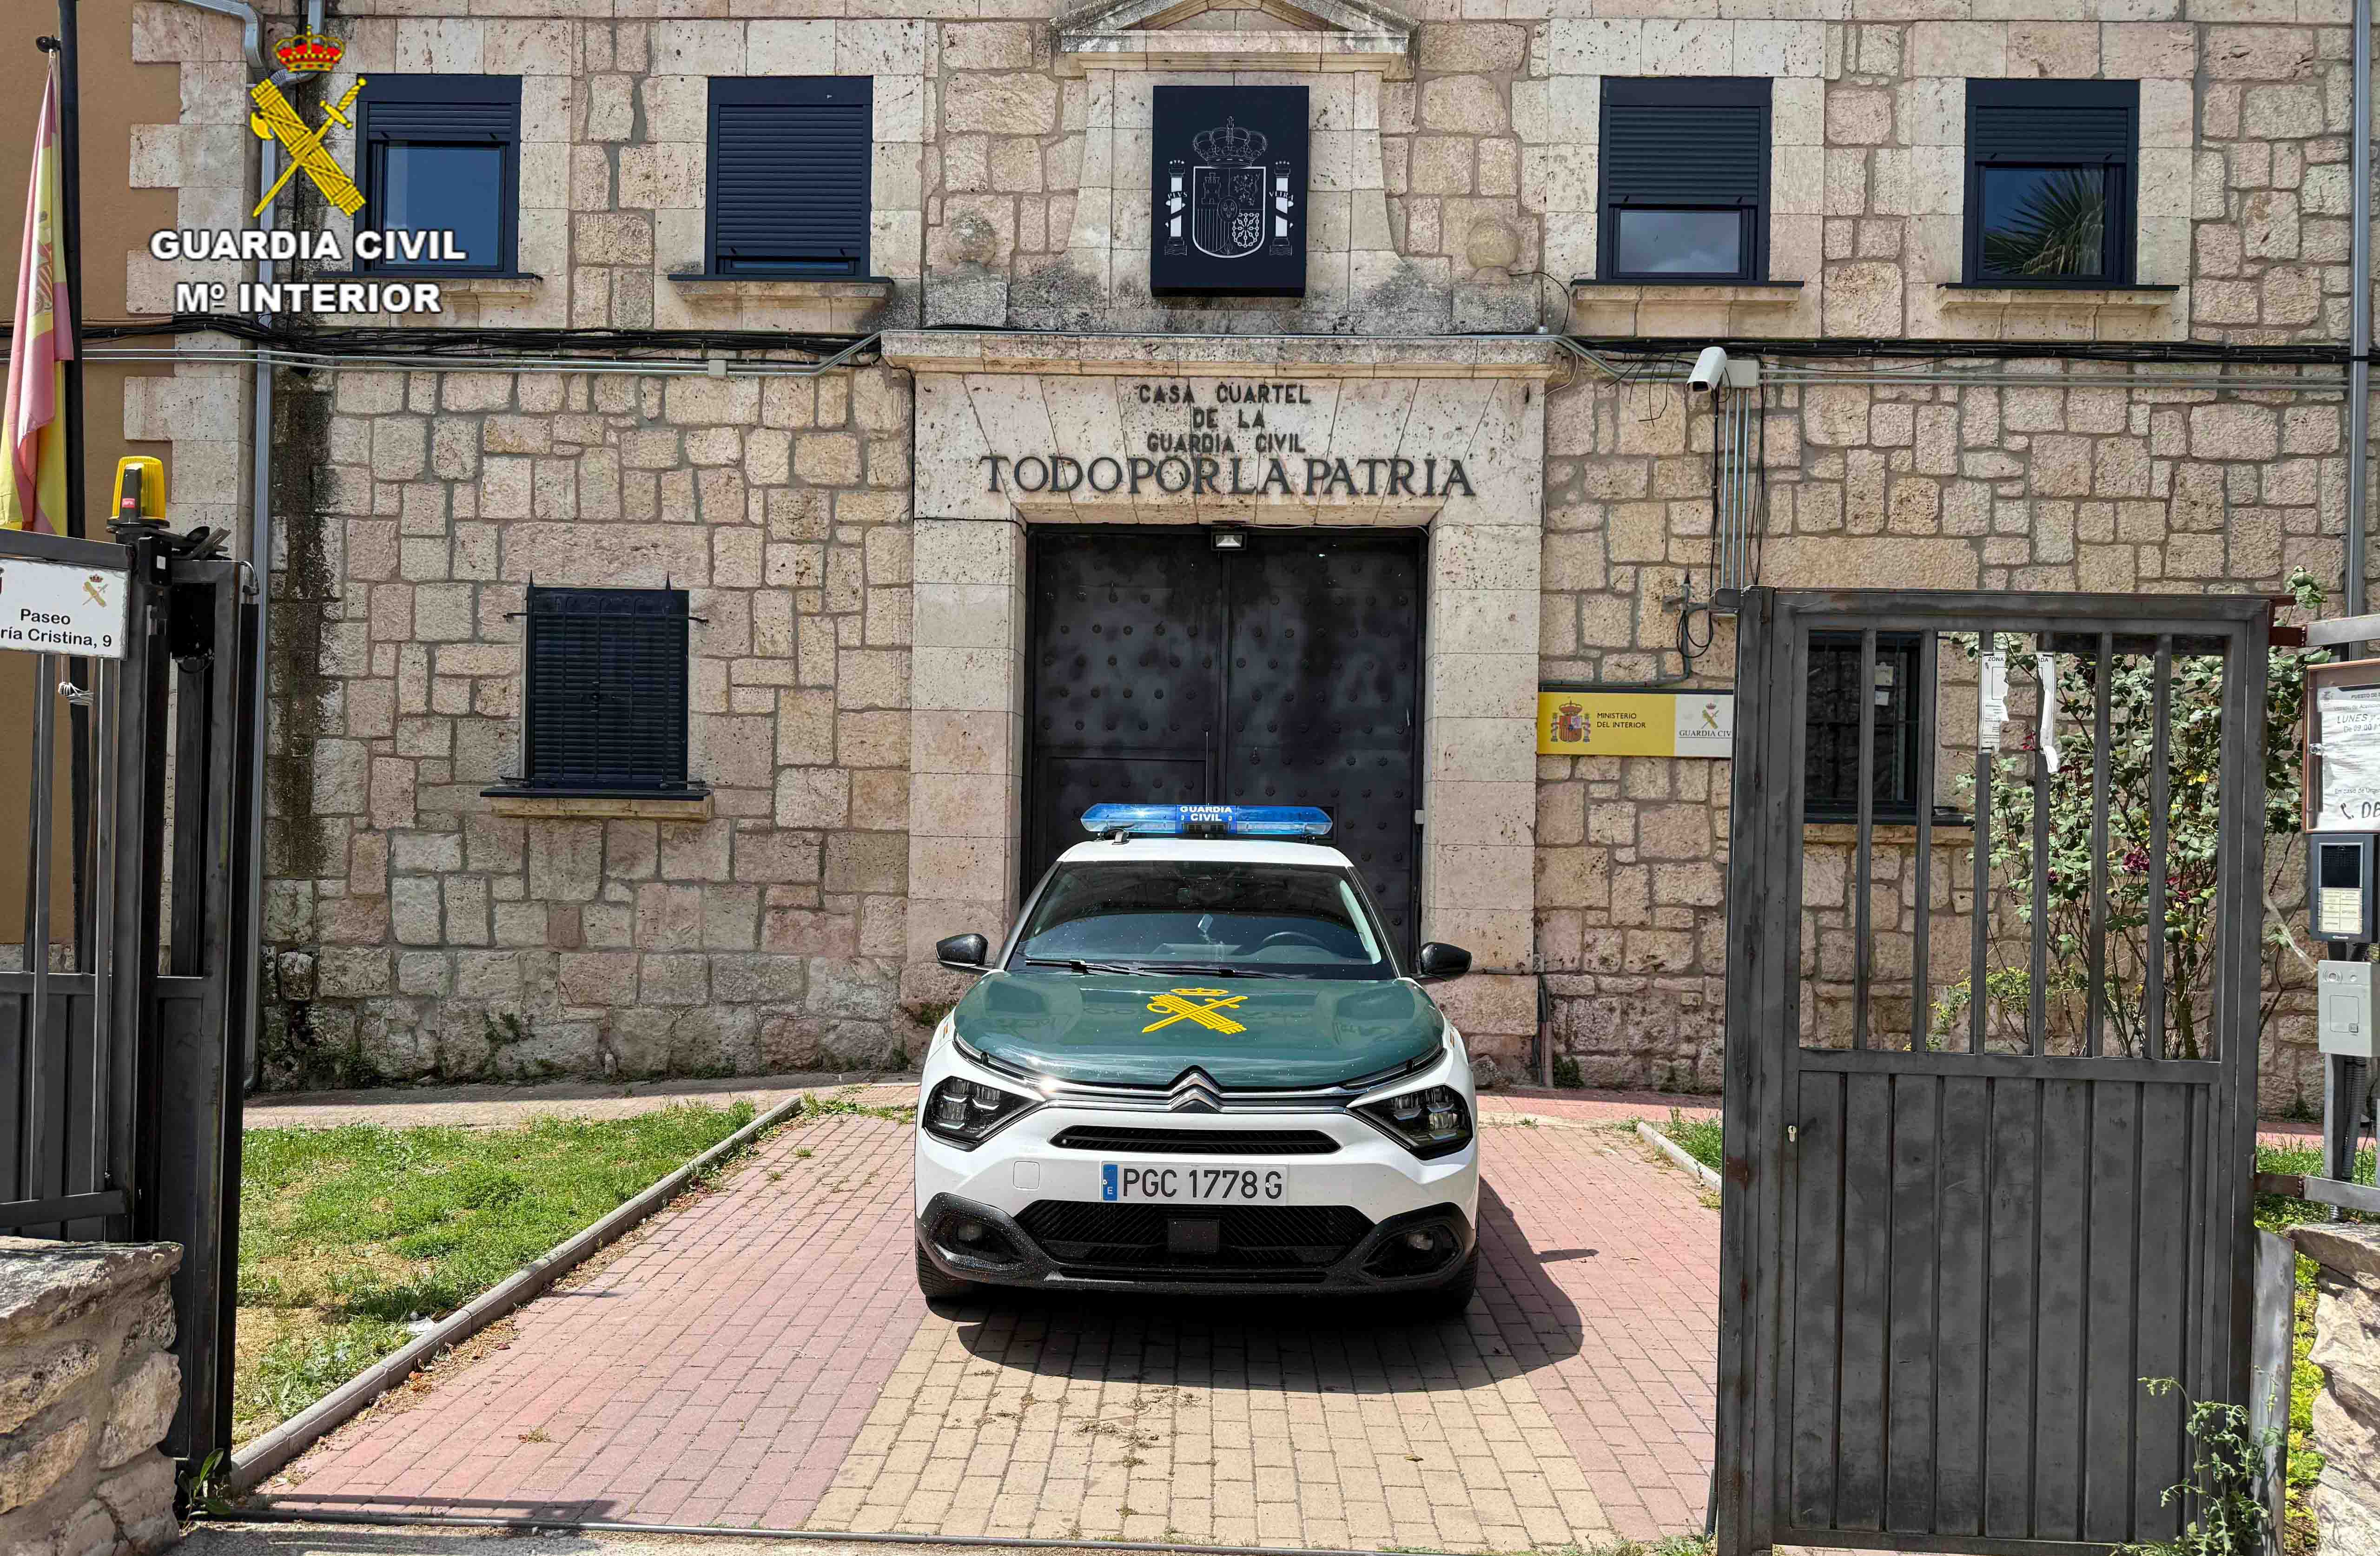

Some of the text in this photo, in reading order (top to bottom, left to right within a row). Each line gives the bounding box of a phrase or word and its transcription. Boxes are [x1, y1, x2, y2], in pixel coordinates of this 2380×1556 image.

[1139, 383, 1311, 403] CASA CUARTEL
[1192, 407, 1265, 428] DE LA
[1146, 433, 1306, 453] GUARDIA CIVIL
[979, 454, 1477, 496] TODO POR LA PATRIA
[20, 608, 71, 625] Paseo
[0, 626, 112, 649] ría Cristina, 9
[2337, 713, 2368, 724] LUNES
[1190, 813, 1222, 821] CIVIL
[1107, 1186, 1113, 1194] E
[1123, 1168, 1283, 1199] PGC 1778 G
